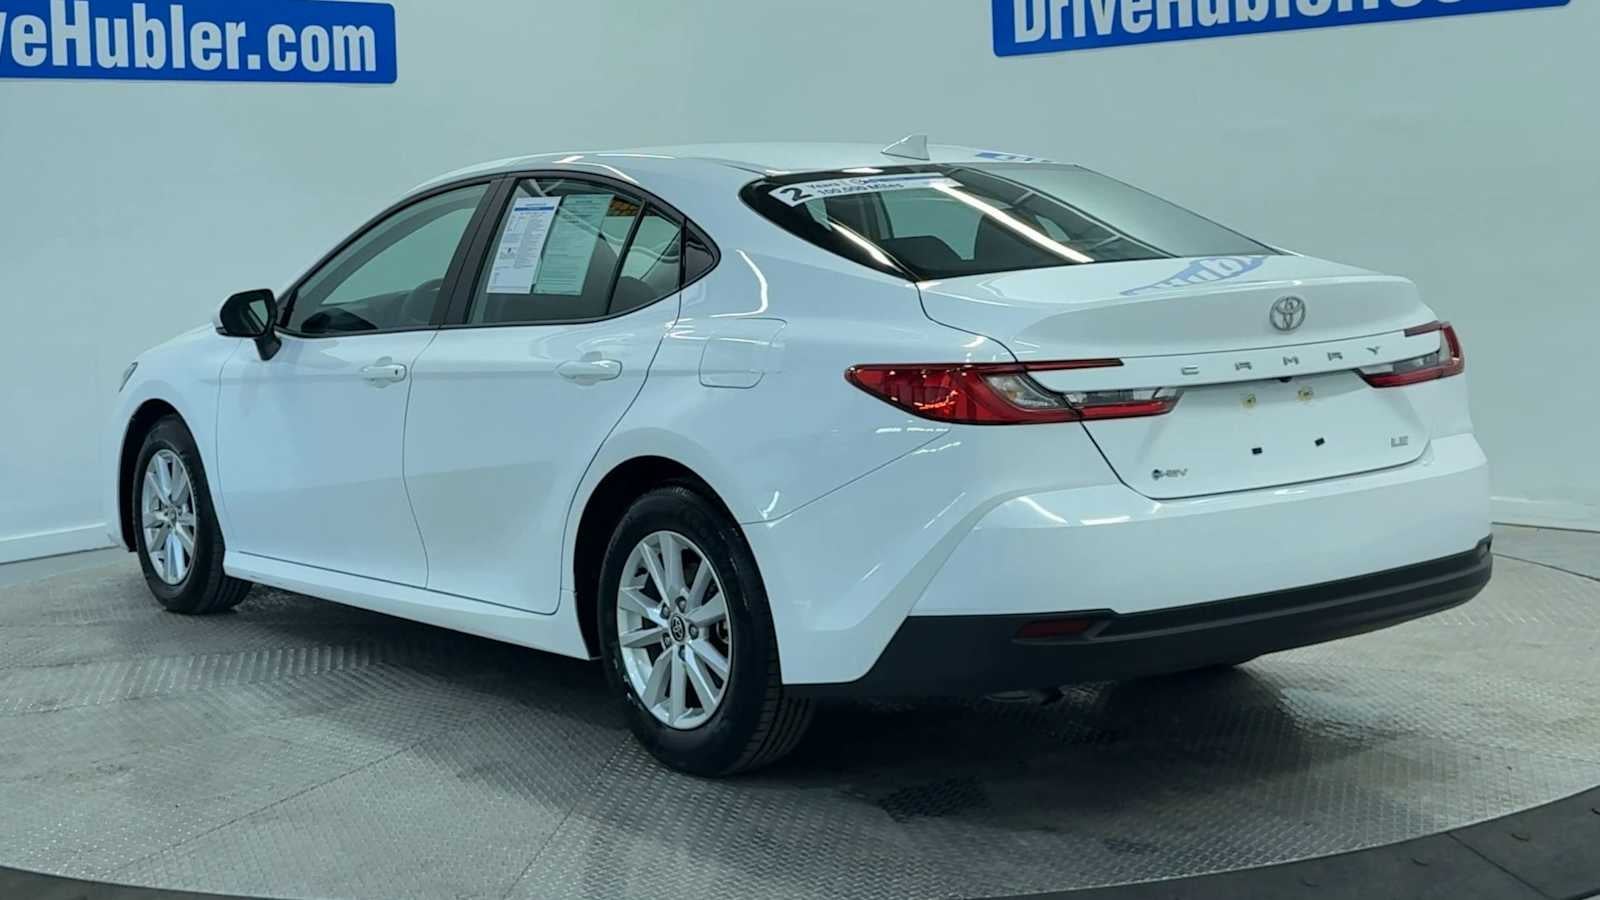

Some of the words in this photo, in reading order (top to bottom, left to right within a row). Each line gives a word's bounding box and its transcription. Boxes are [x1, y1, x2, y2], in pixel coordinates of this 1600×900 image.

[0, 0, 376, 72] eHubler.com
[779, 187, 814, 202] 2
[1181, 346, 1380, 376] CAMRY
[1391, 436, 1409, 448] LE
